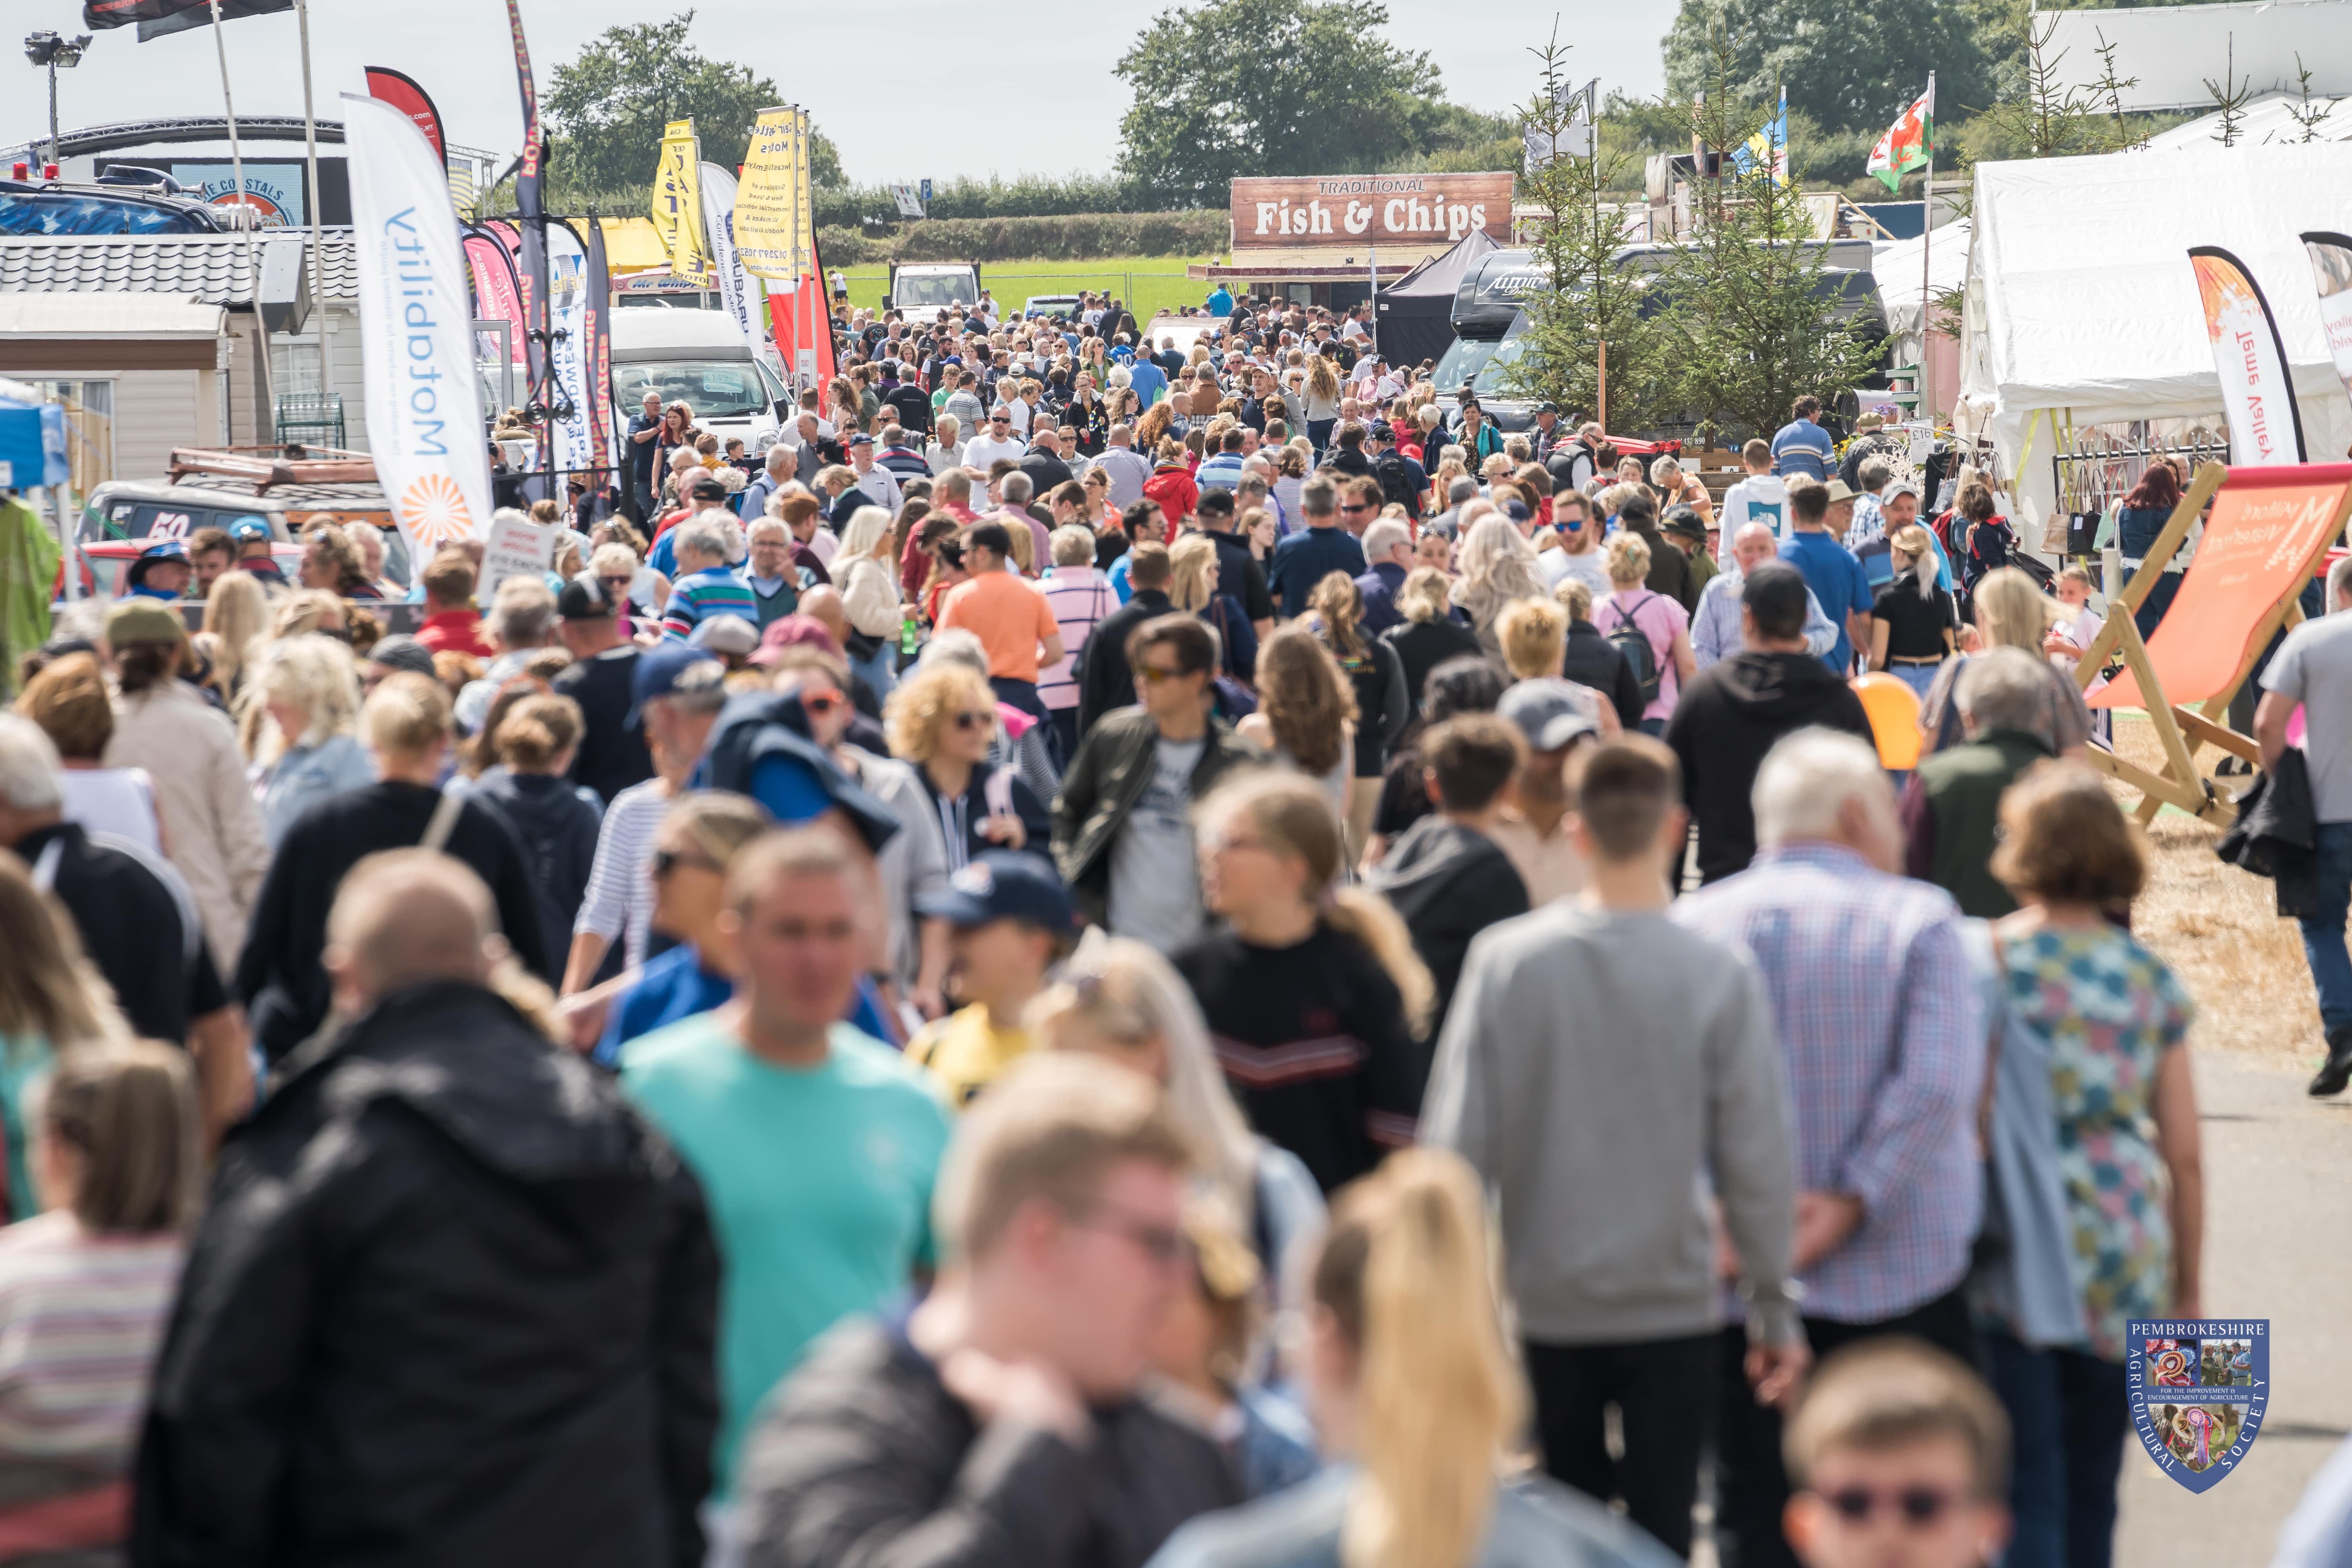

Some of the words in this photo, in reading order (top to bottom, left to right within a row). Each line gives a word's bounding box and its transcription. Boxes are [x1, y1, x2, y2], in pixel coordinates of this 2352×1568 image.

[220, 179, 283, 200] COSTALS
[923, 181, 930, 198] P
[1317, 179, 1427, 195] TRADITIONAL
[1255, 198, 1334, 235] Fish
[1344, 200, 1374, 234] &
[1384, 194, 1486, 241] Chips
[716, 215, 727, 279] Confidence
[633, 279, 654, 288] Mr
[658, 278, 701, 289] Whipp
[732, 250, 749, 334] SUBARU
[1093, 315, 1100, 326] 9
[1913, 429, 1931, 440] £16
